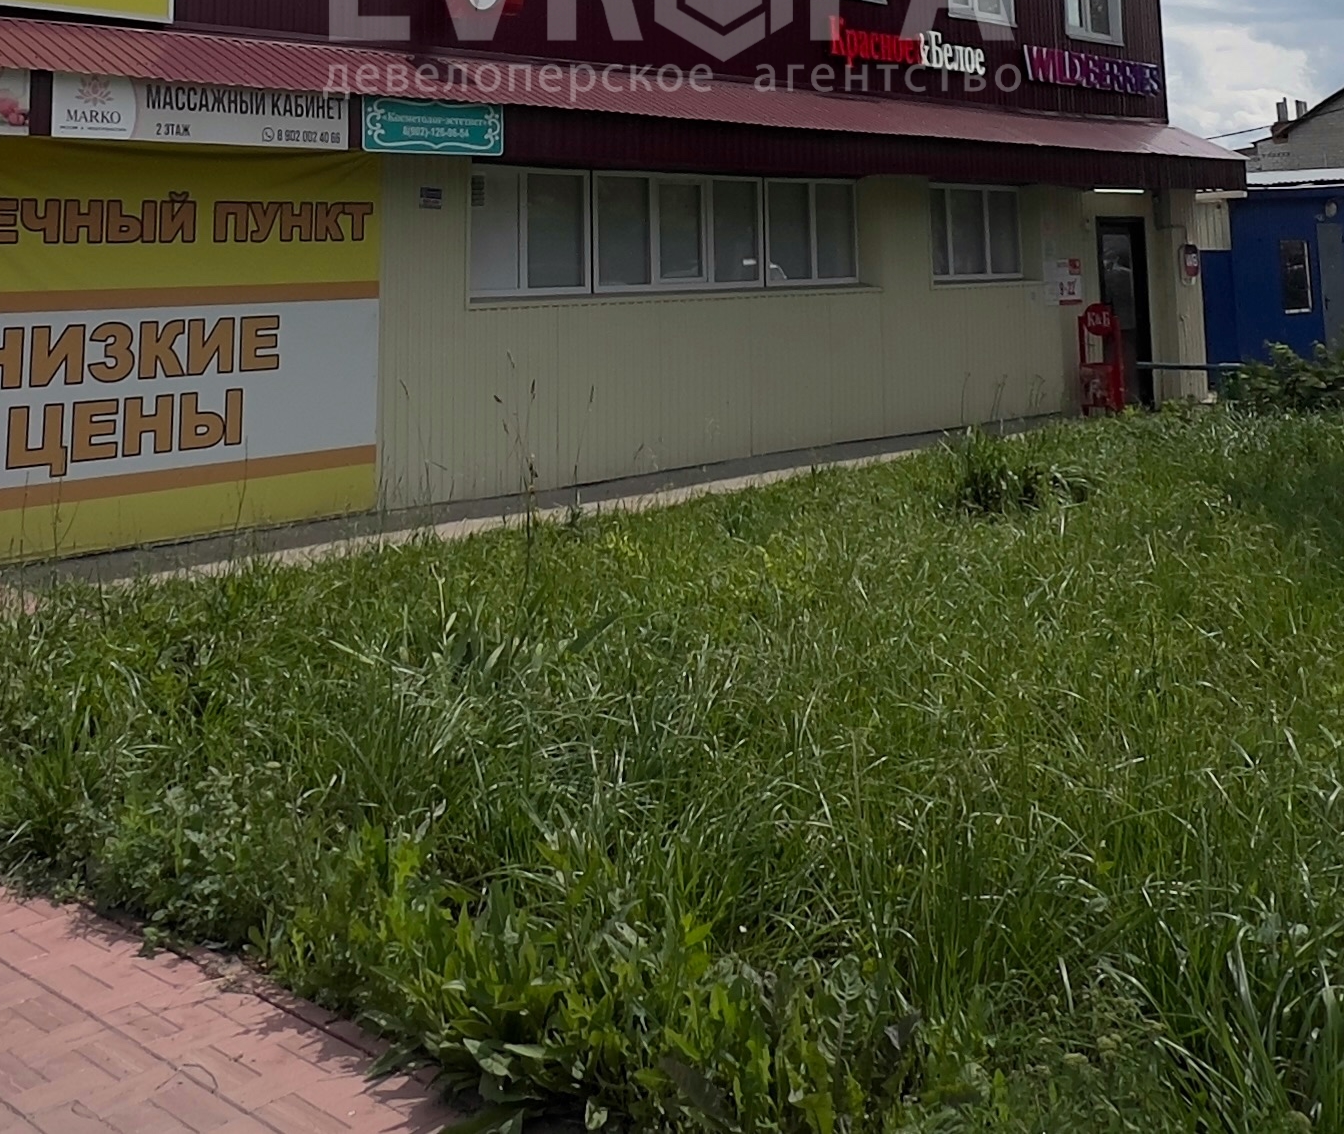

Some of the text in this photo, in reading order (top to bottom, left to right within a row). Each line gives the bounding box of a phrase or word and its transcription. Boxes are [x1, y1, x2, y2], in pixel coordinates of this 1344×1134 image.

[146, 83, 345, 120] МАССАЖНЫЙ КАБИНЕТ
[66, 109, 122, 124] MARKO
[156, 123, 191, 137] 2 ЭТАЖ
[276, 129, 283, 141] 8
[213, 200, 374, 244] ПУНКТ
[6, 388, 244, 478] ЦЕНЫ
